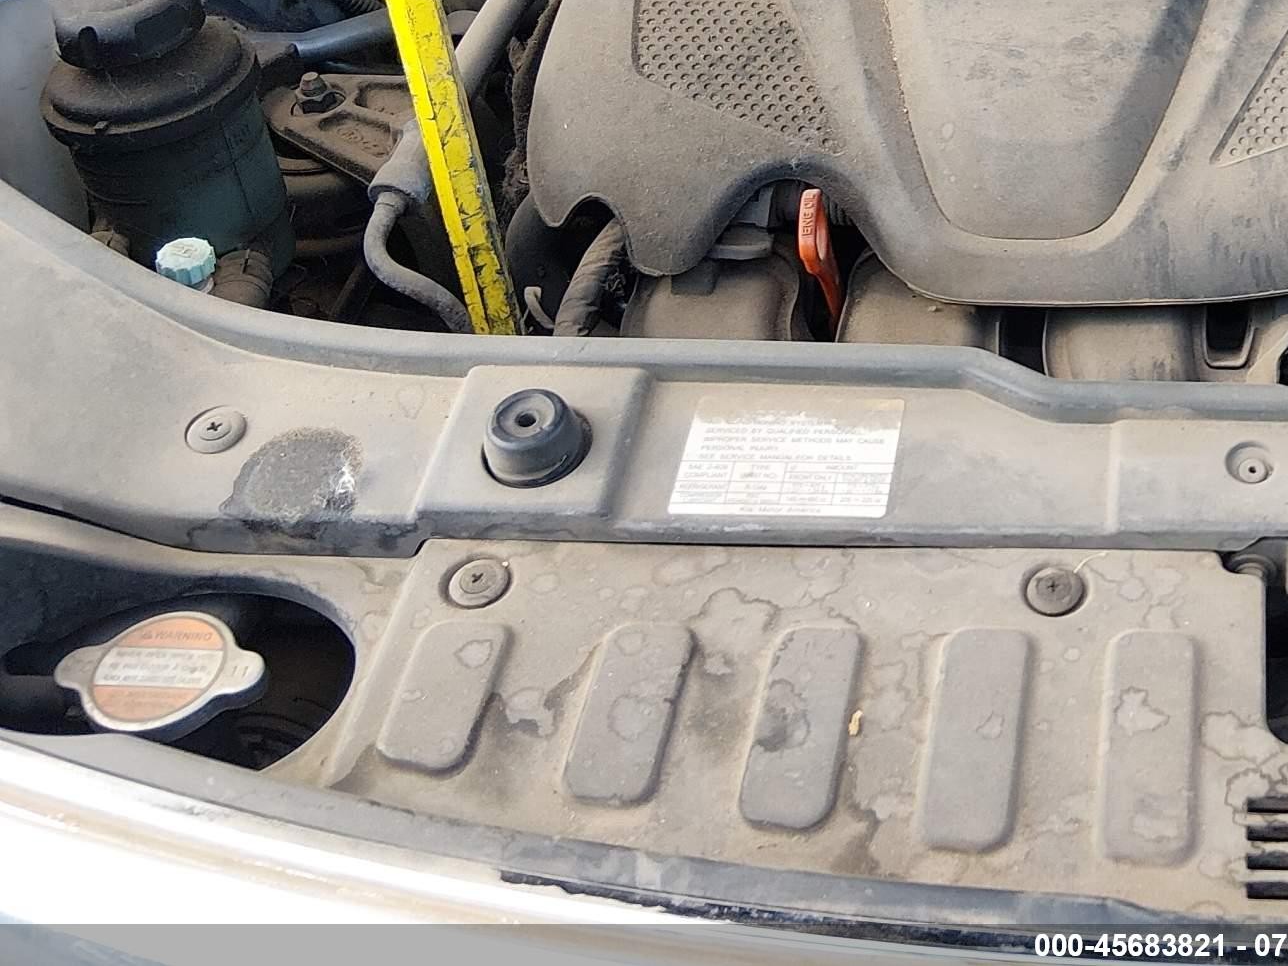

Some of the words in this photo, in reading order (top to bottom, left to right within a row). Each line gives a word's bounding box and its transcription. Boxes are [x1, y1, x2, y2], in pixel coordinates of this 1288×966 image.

[804, 193, 817, 210] OIL
[801, 212, 814, 236] ENG
[155, 632, 213, 642] WARNING
